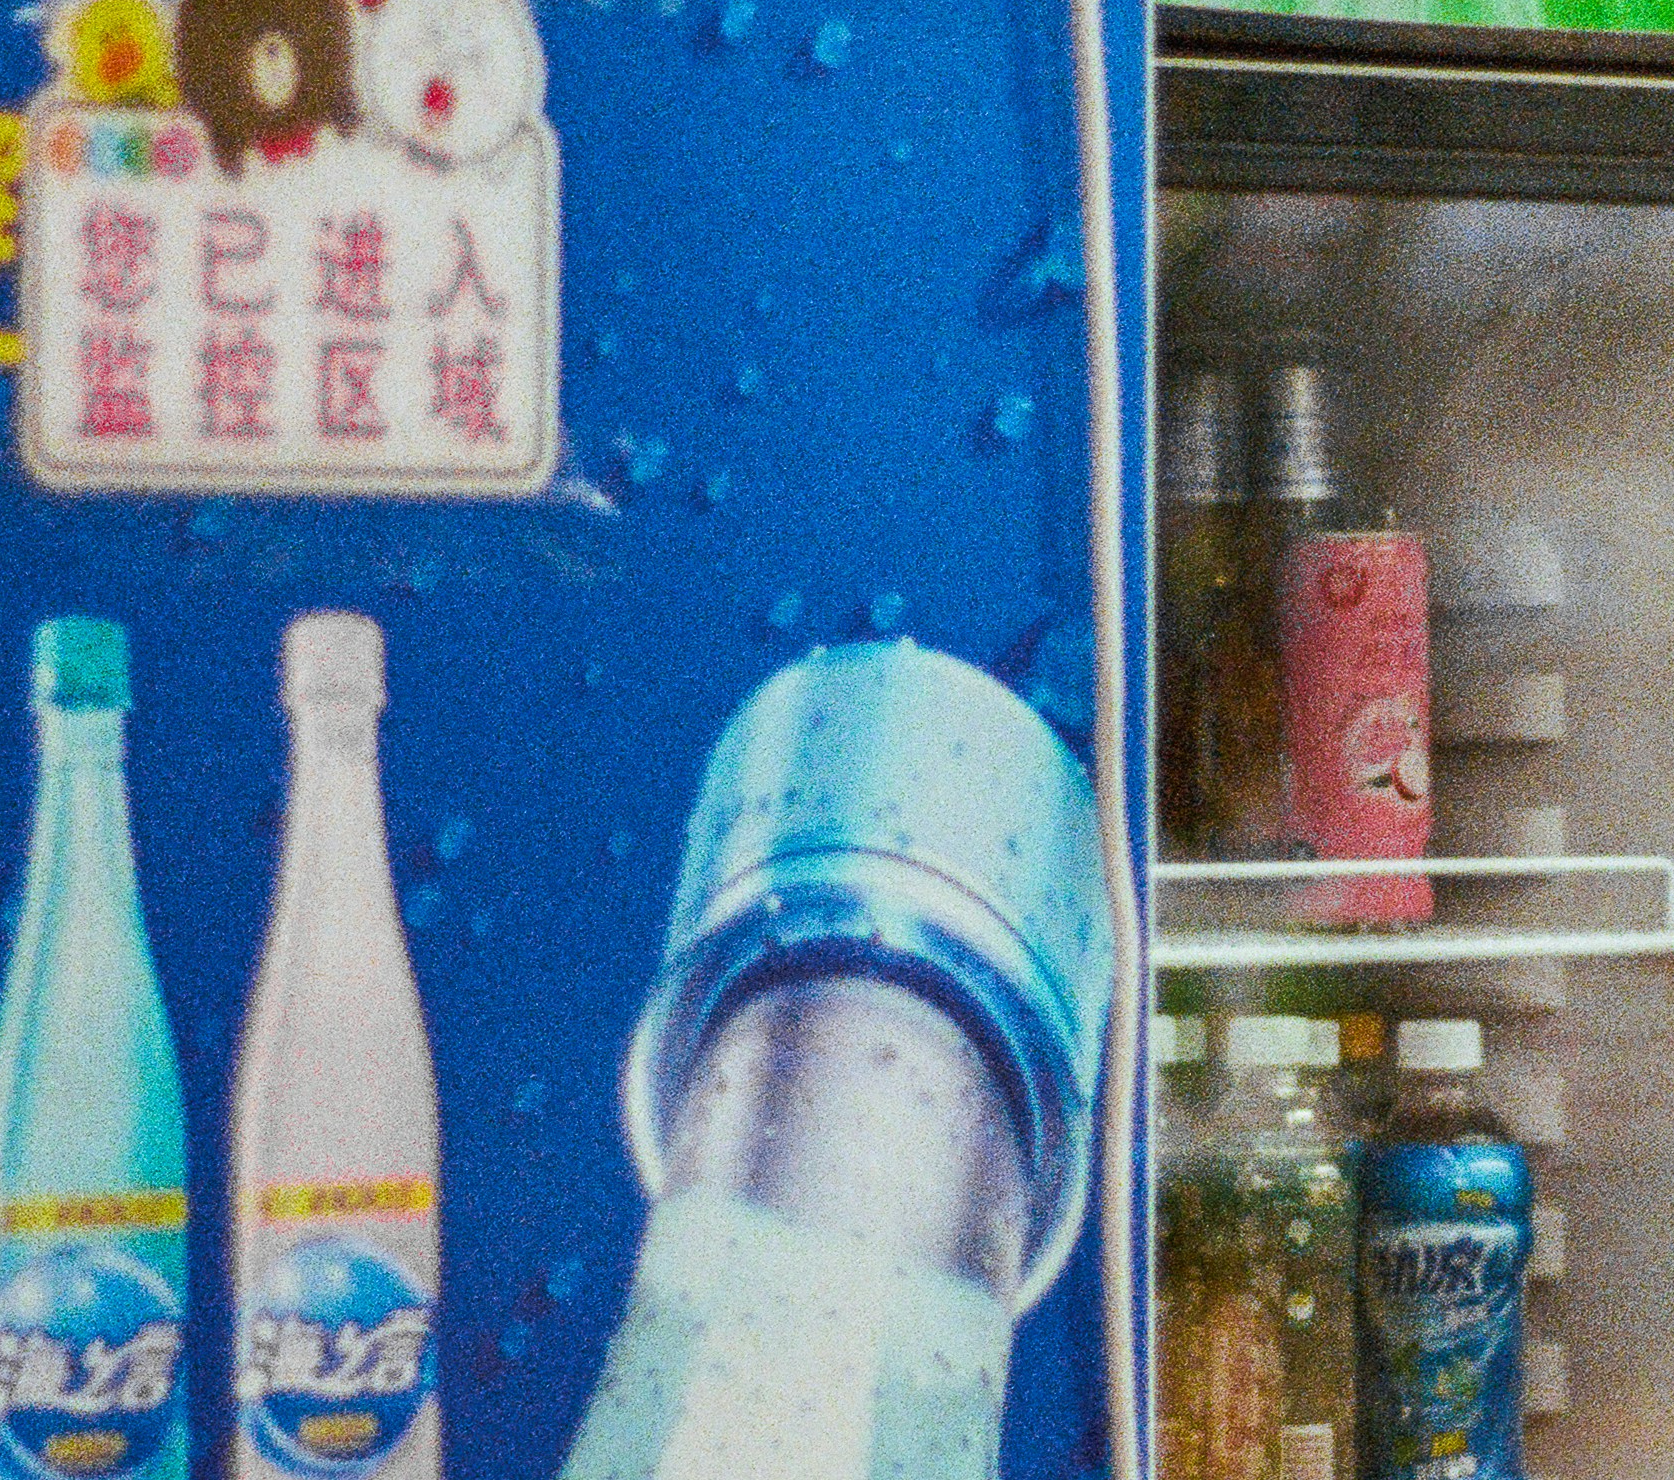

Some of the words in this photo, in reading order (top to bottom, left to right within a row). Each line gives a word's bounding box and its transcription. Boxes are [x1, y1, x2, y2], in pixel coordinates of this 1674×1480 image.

[77, 206, 507, 320] 您已进入
[77, 331, 508, 444] 监控区域
